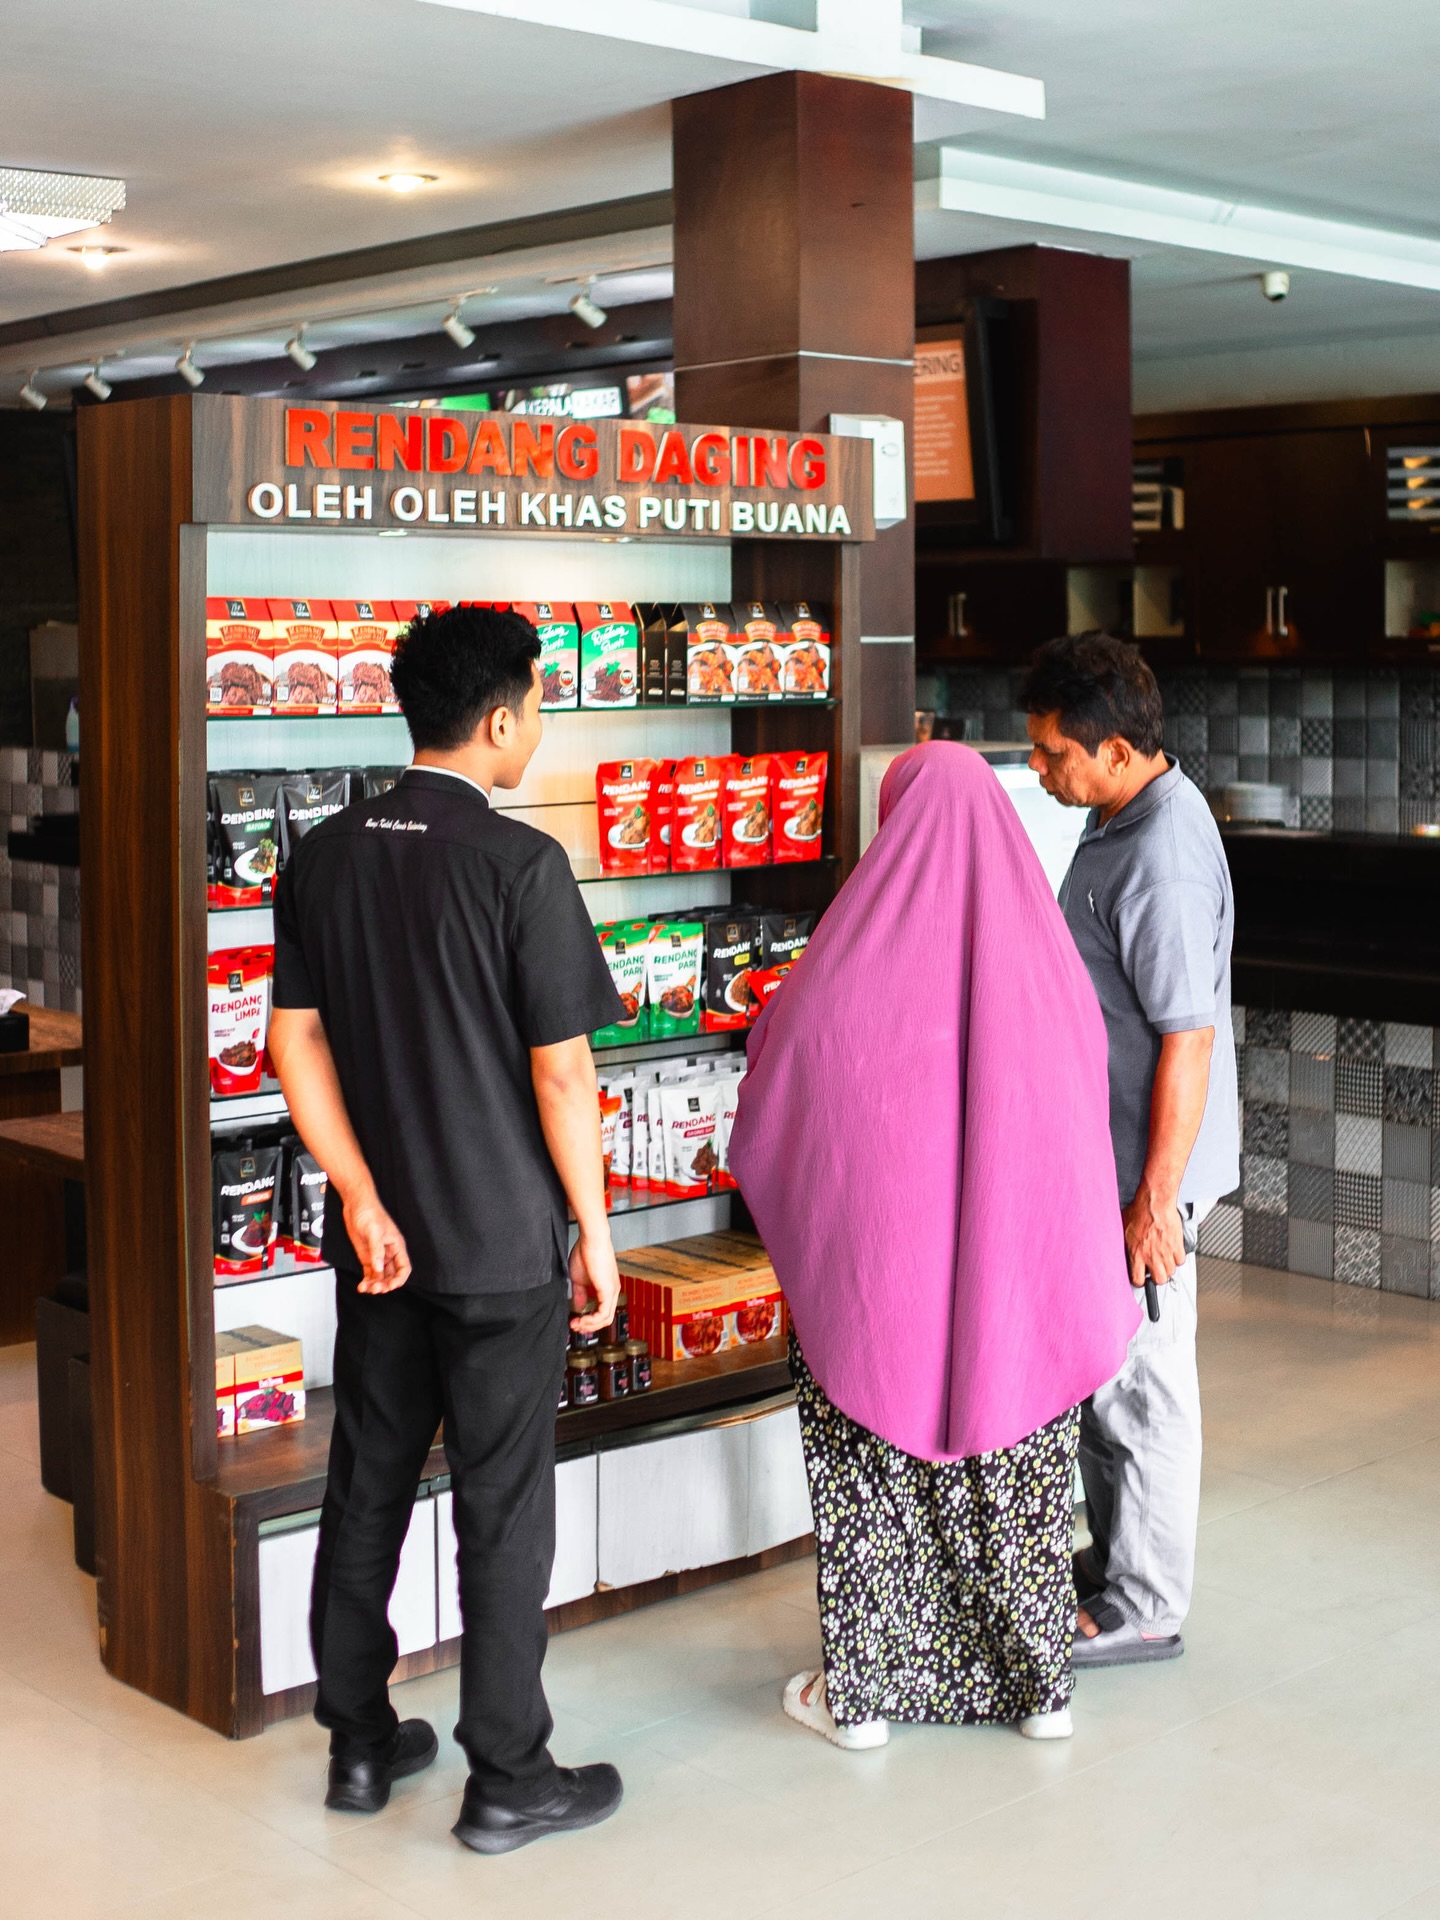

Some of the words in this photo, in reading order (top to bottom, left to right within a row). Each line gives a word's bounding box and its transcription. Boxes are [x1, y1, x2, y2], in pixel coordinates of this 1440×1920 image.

[914, 353, 960, 377] ERING
[285, 408, 599, 481] RENDANG
[617, 428, 826, 490] DAGING
[247, 482, 373, 520] OLEH
[390, 486, 506, 525] OLEH
[518, 490, 627, 529] KHAS
[638, 497, 721, 531] PUTI
[731, 502, 851, 535] BUANA
[677, 780, 720, 795] RENDAN
[726, 776, 768, 791] RENDAN
[779, 775, 819, 789] RENDAN
[221, 808, 275, 825] DENDENG
[713, 942, 751, 958] RENDAN
[608, 955, 644, 971] ENDANG
[211, 995, 262, 1013] RENDANG
[221, 1176, 275, 1196] RENDANG
[300, 1172, 328, 1185] REND
